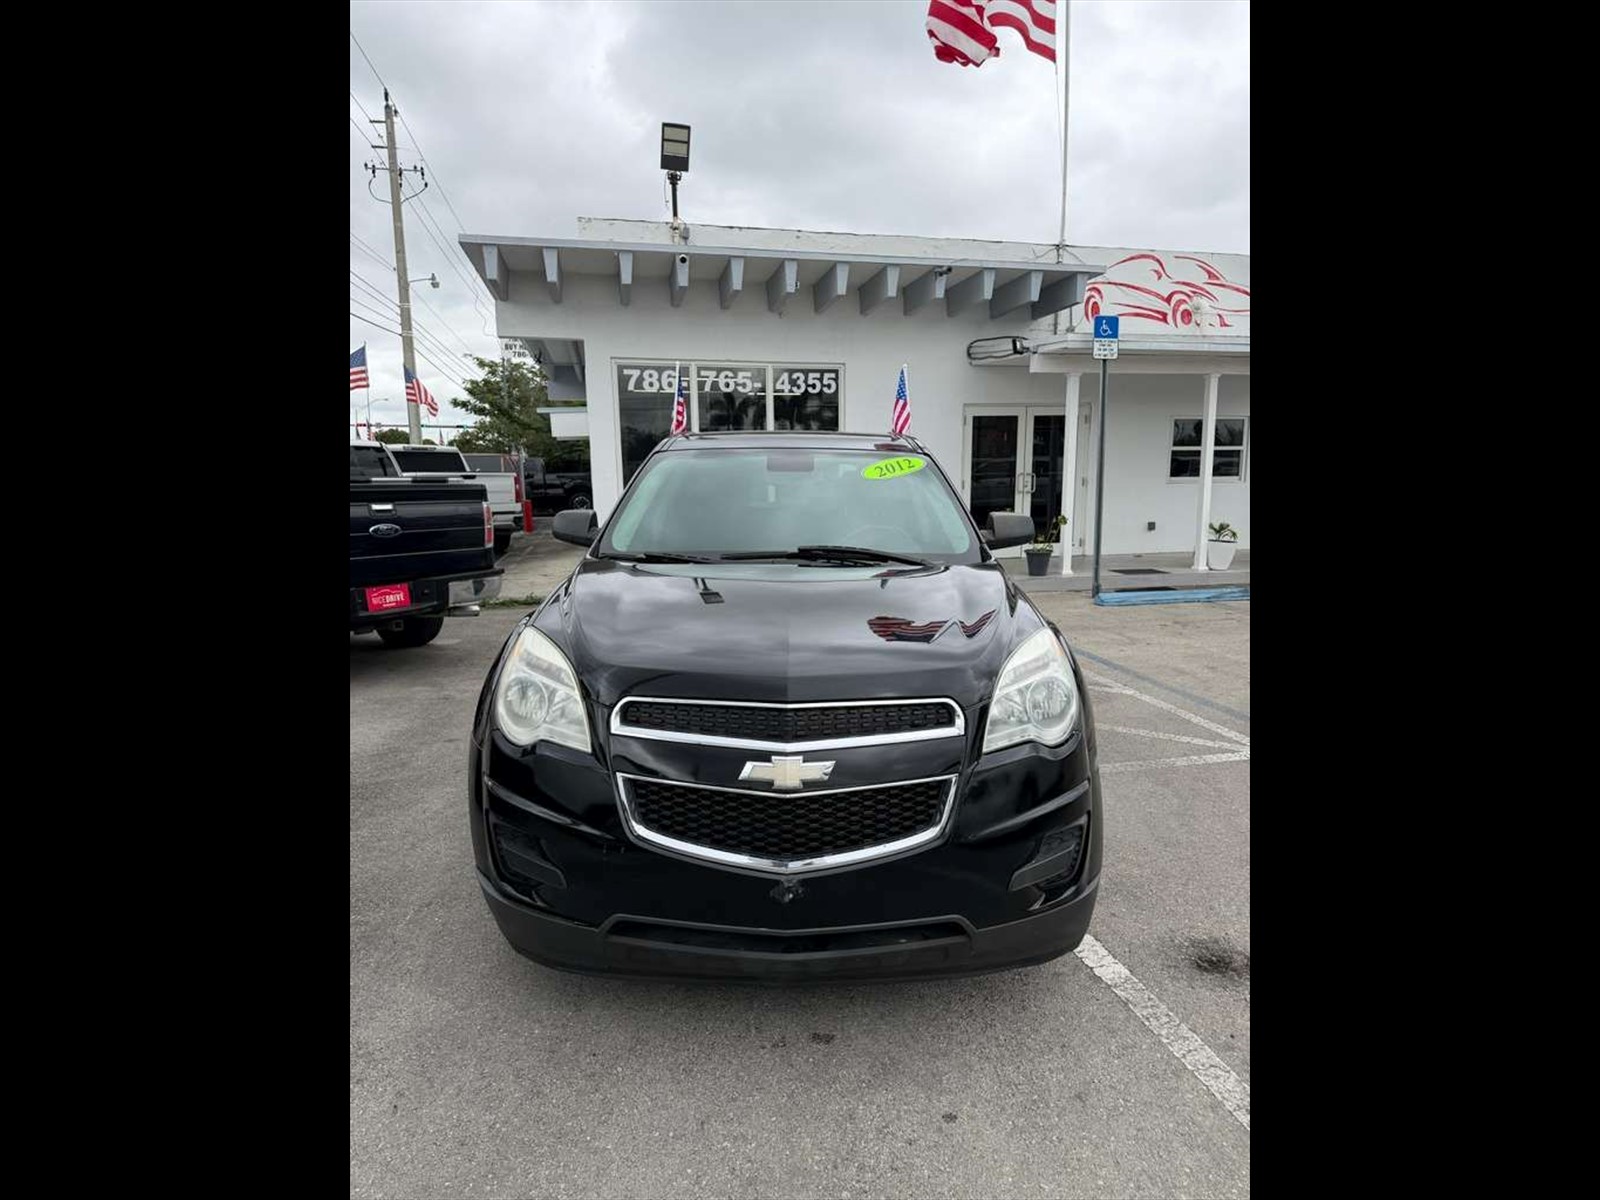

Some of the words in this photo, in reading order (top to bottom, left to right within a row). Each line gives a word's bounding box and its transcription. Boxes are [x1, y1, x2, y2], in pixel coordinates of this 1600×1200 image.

[700, 370, 762, 393] 765-
[776, 372, 837, 394] 4355
[874, 458, 916, 478] 2012
